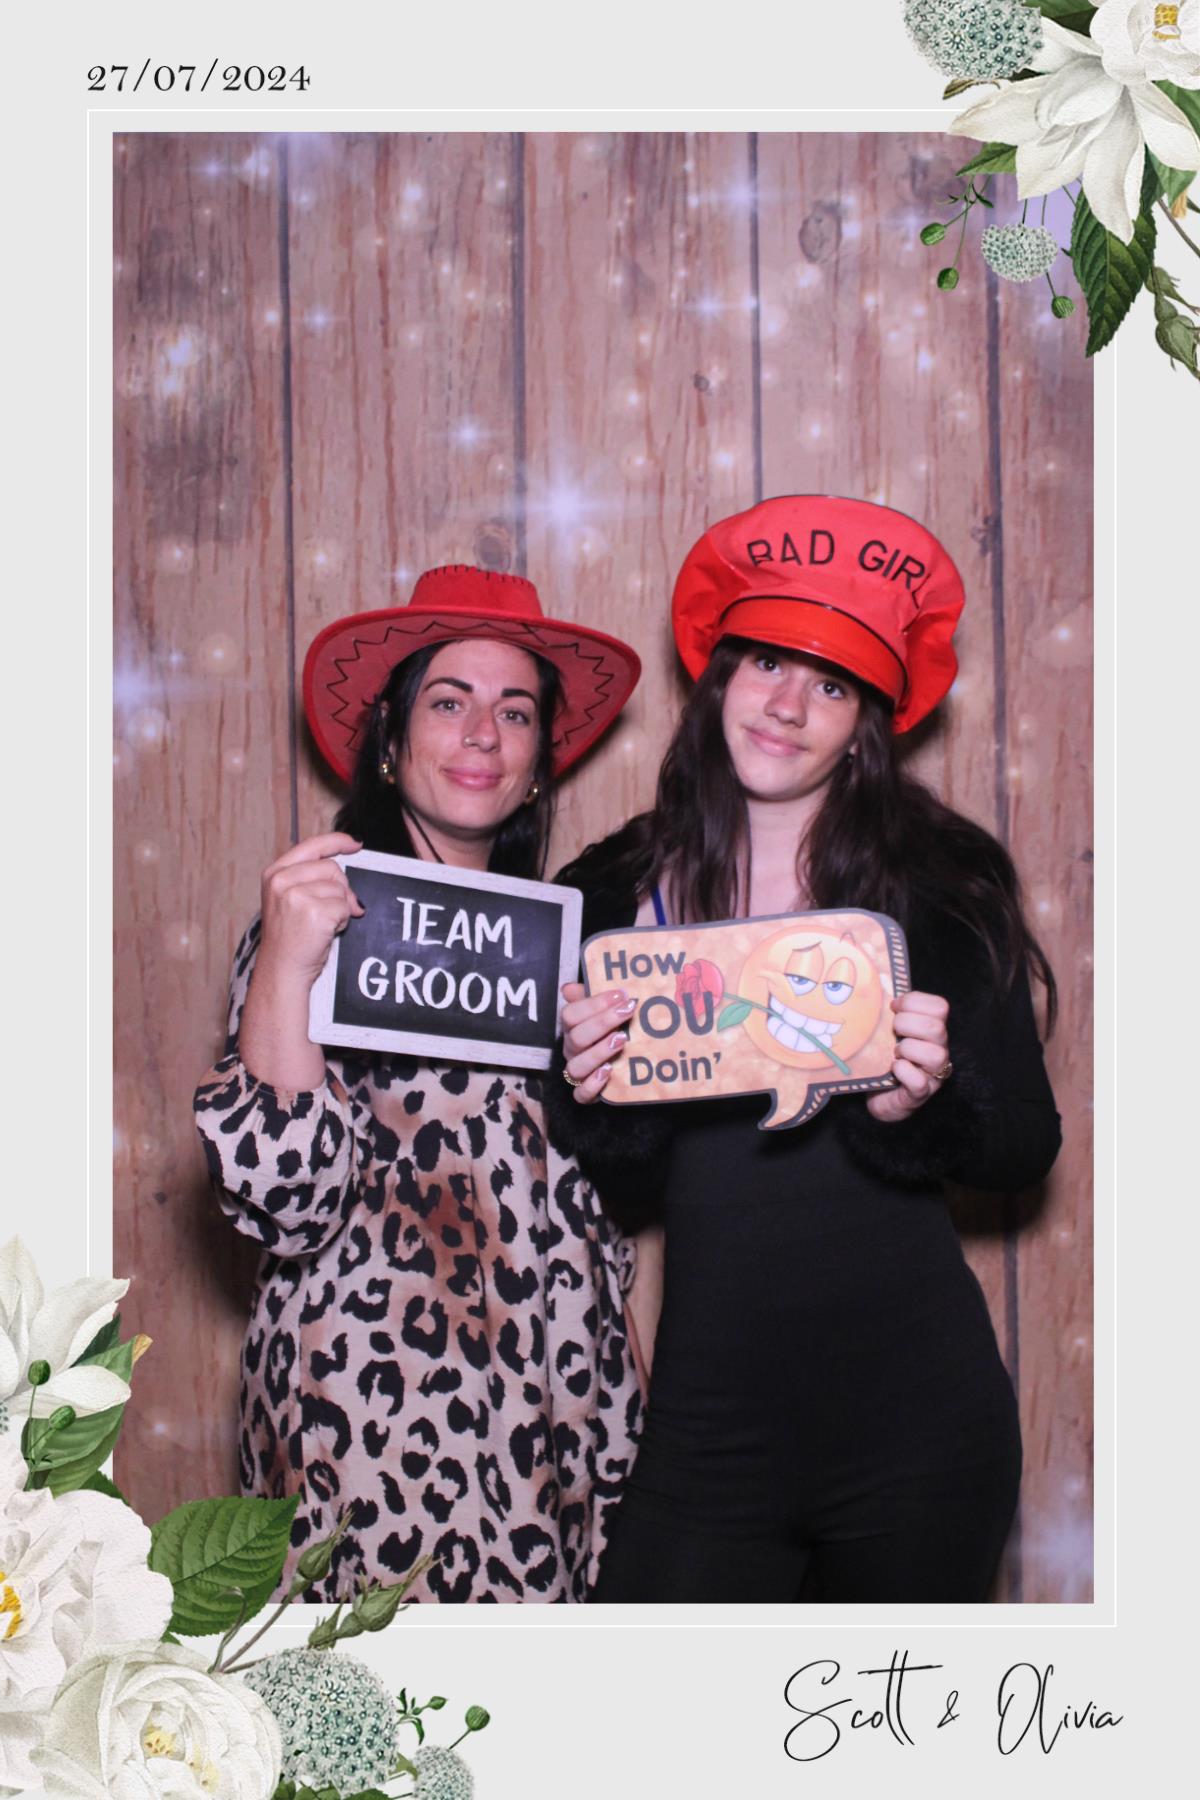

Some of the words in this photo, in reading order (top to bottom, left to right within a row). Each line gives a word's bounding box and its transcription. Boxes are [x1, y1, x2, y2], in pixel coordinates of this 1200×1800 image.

[747, 529, 835, 567] BAD
[858, 540, 932, 610] GIRL
[397, 897, 513, 959] TEAM
[358, 956, 538, 1023] GROOM
[603, 950, 686, 981] How
[627, 991, 715, 1041] OU
